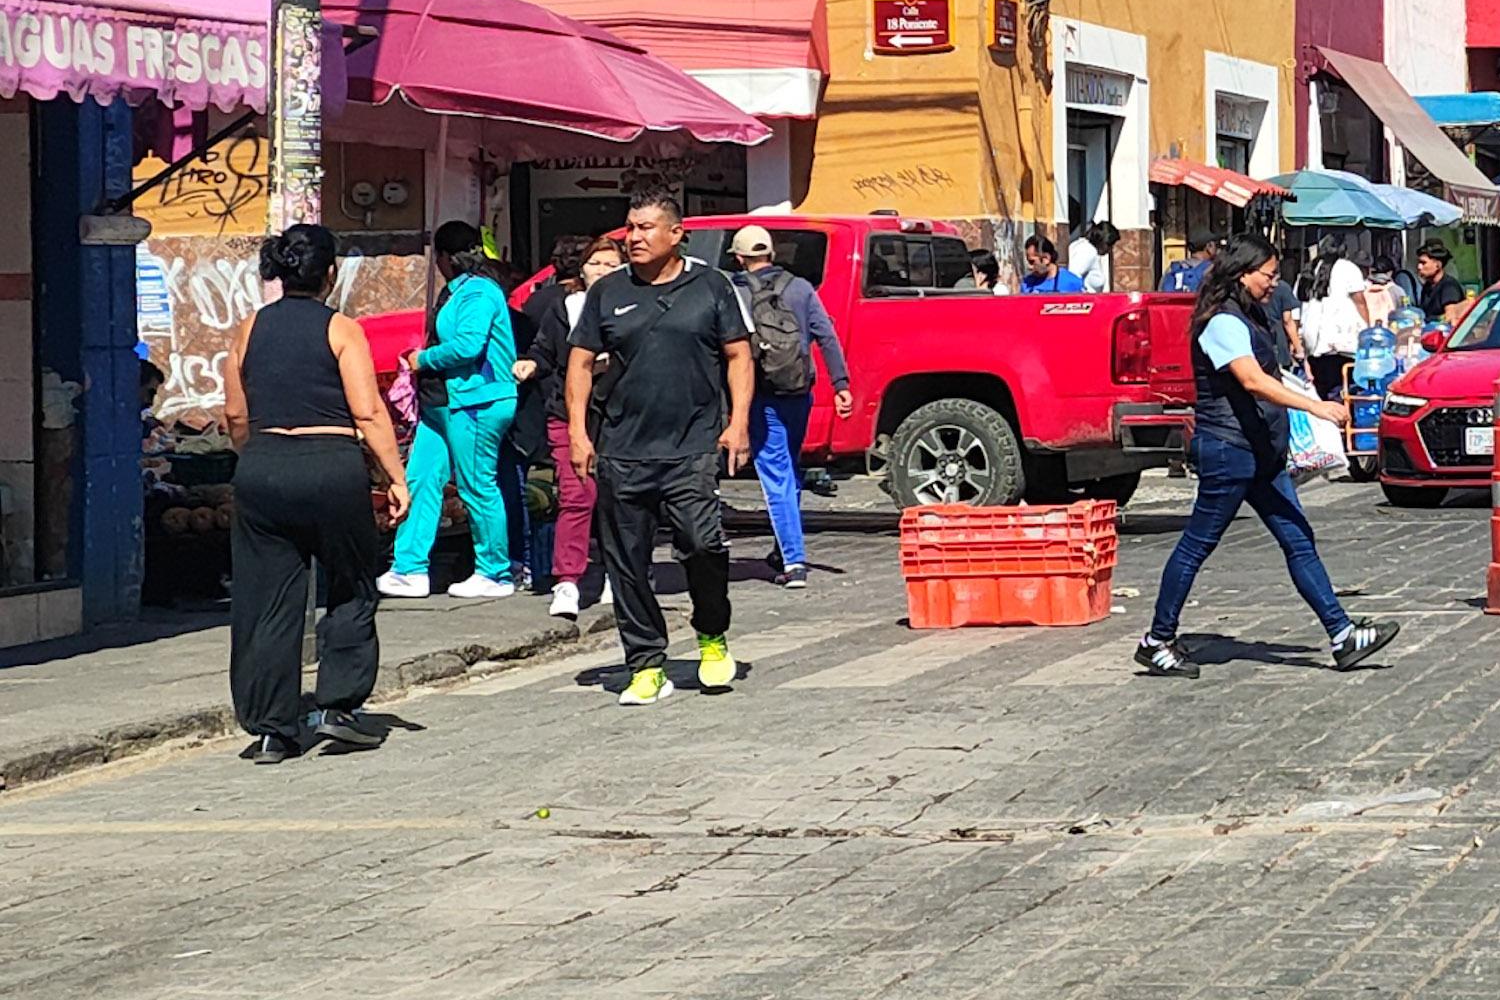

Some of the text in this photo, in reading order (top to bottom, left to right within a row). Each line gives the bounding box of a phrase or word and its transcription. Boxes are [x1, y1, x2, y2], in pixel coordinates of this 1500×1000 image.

[886, 18, 938, 31] 18 Poniente
[0, 10, 267, 89] AGUAS FRESCAS
